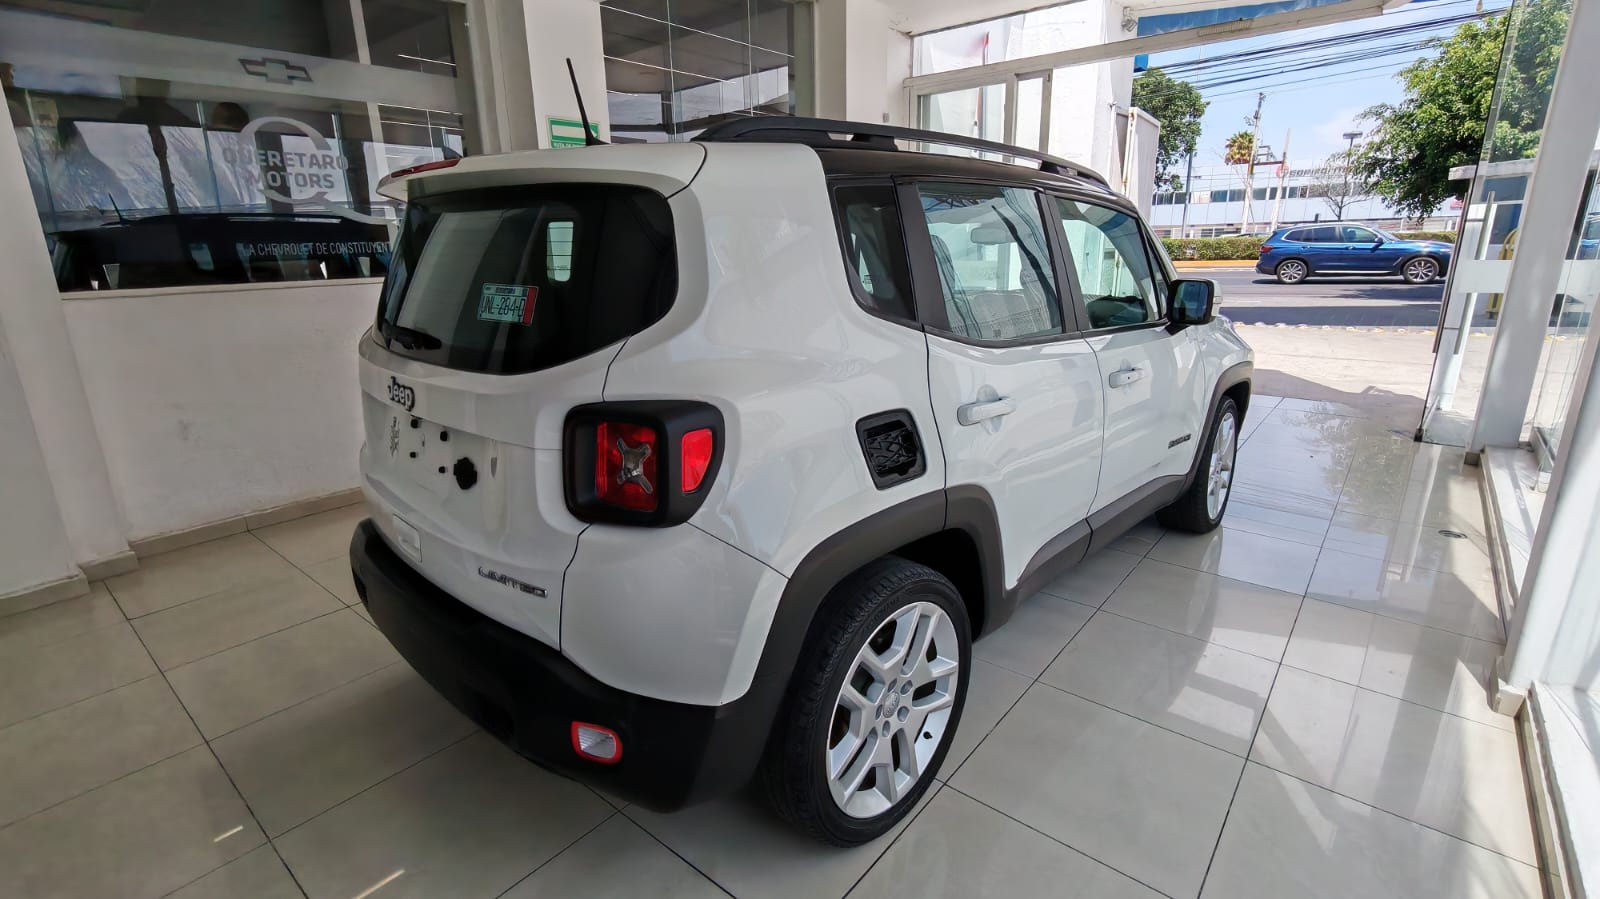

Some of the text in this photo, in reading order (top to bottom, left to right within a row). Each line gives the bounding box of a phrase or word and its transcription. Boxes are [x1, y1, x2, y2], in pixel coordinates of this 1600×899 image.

[246, 169, 335, 190] MOTORS
[258, 242, 314, 257] CHEVROLET
[316, 242, 330, 256] DE
[387, 375, 416, 413] Jeep
